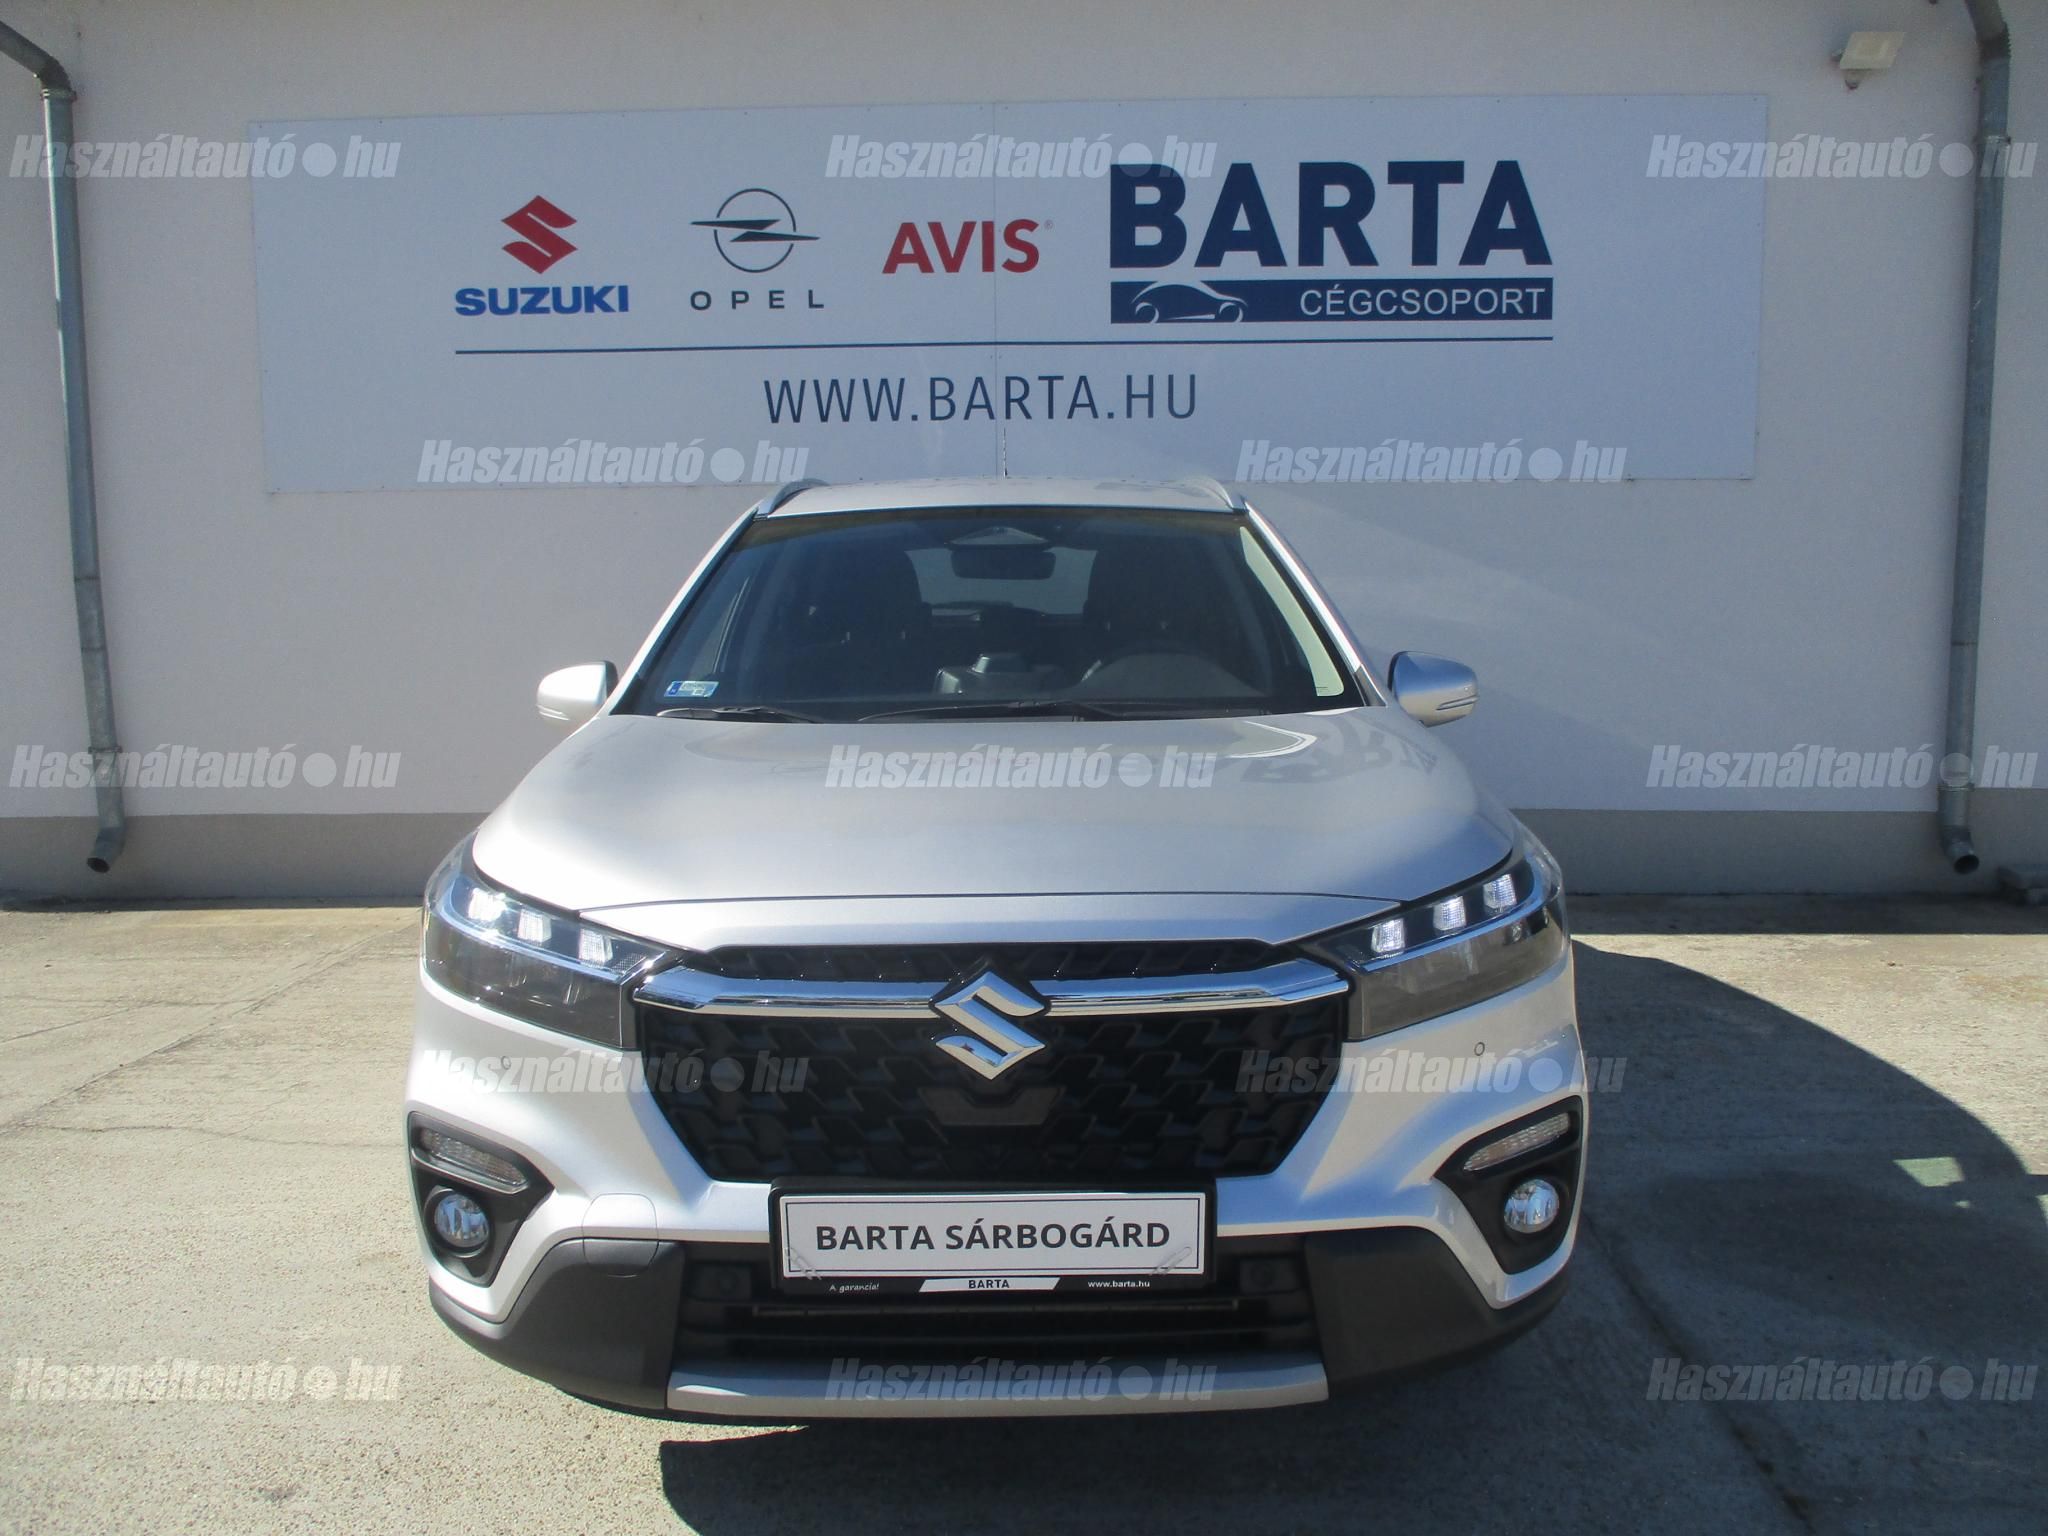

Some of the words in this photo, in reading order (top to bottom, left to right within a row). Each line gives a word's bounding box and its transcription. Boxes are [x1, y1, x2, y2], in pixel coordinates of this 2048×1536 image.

[1110, 160, 1553, 269] BARTA
[883, 219, 1040, 274] AVIS
[455, 285, 630, 316] SUZUKI
[690, 289, 825, 311] OPEL
[1300, 284, 1546, 317] CÉGCSOPORT
[763, 374, 1197, 424] WWW.BARTA.HU
[815, 1224, 935, 1250] BARTA
[945, 1216, 1171, 1249] SÁRBOGÁRD
[968, 1279, 1010, 1289] BARTA
[1087, 1279, 1151, 1289] www.barta.hu
